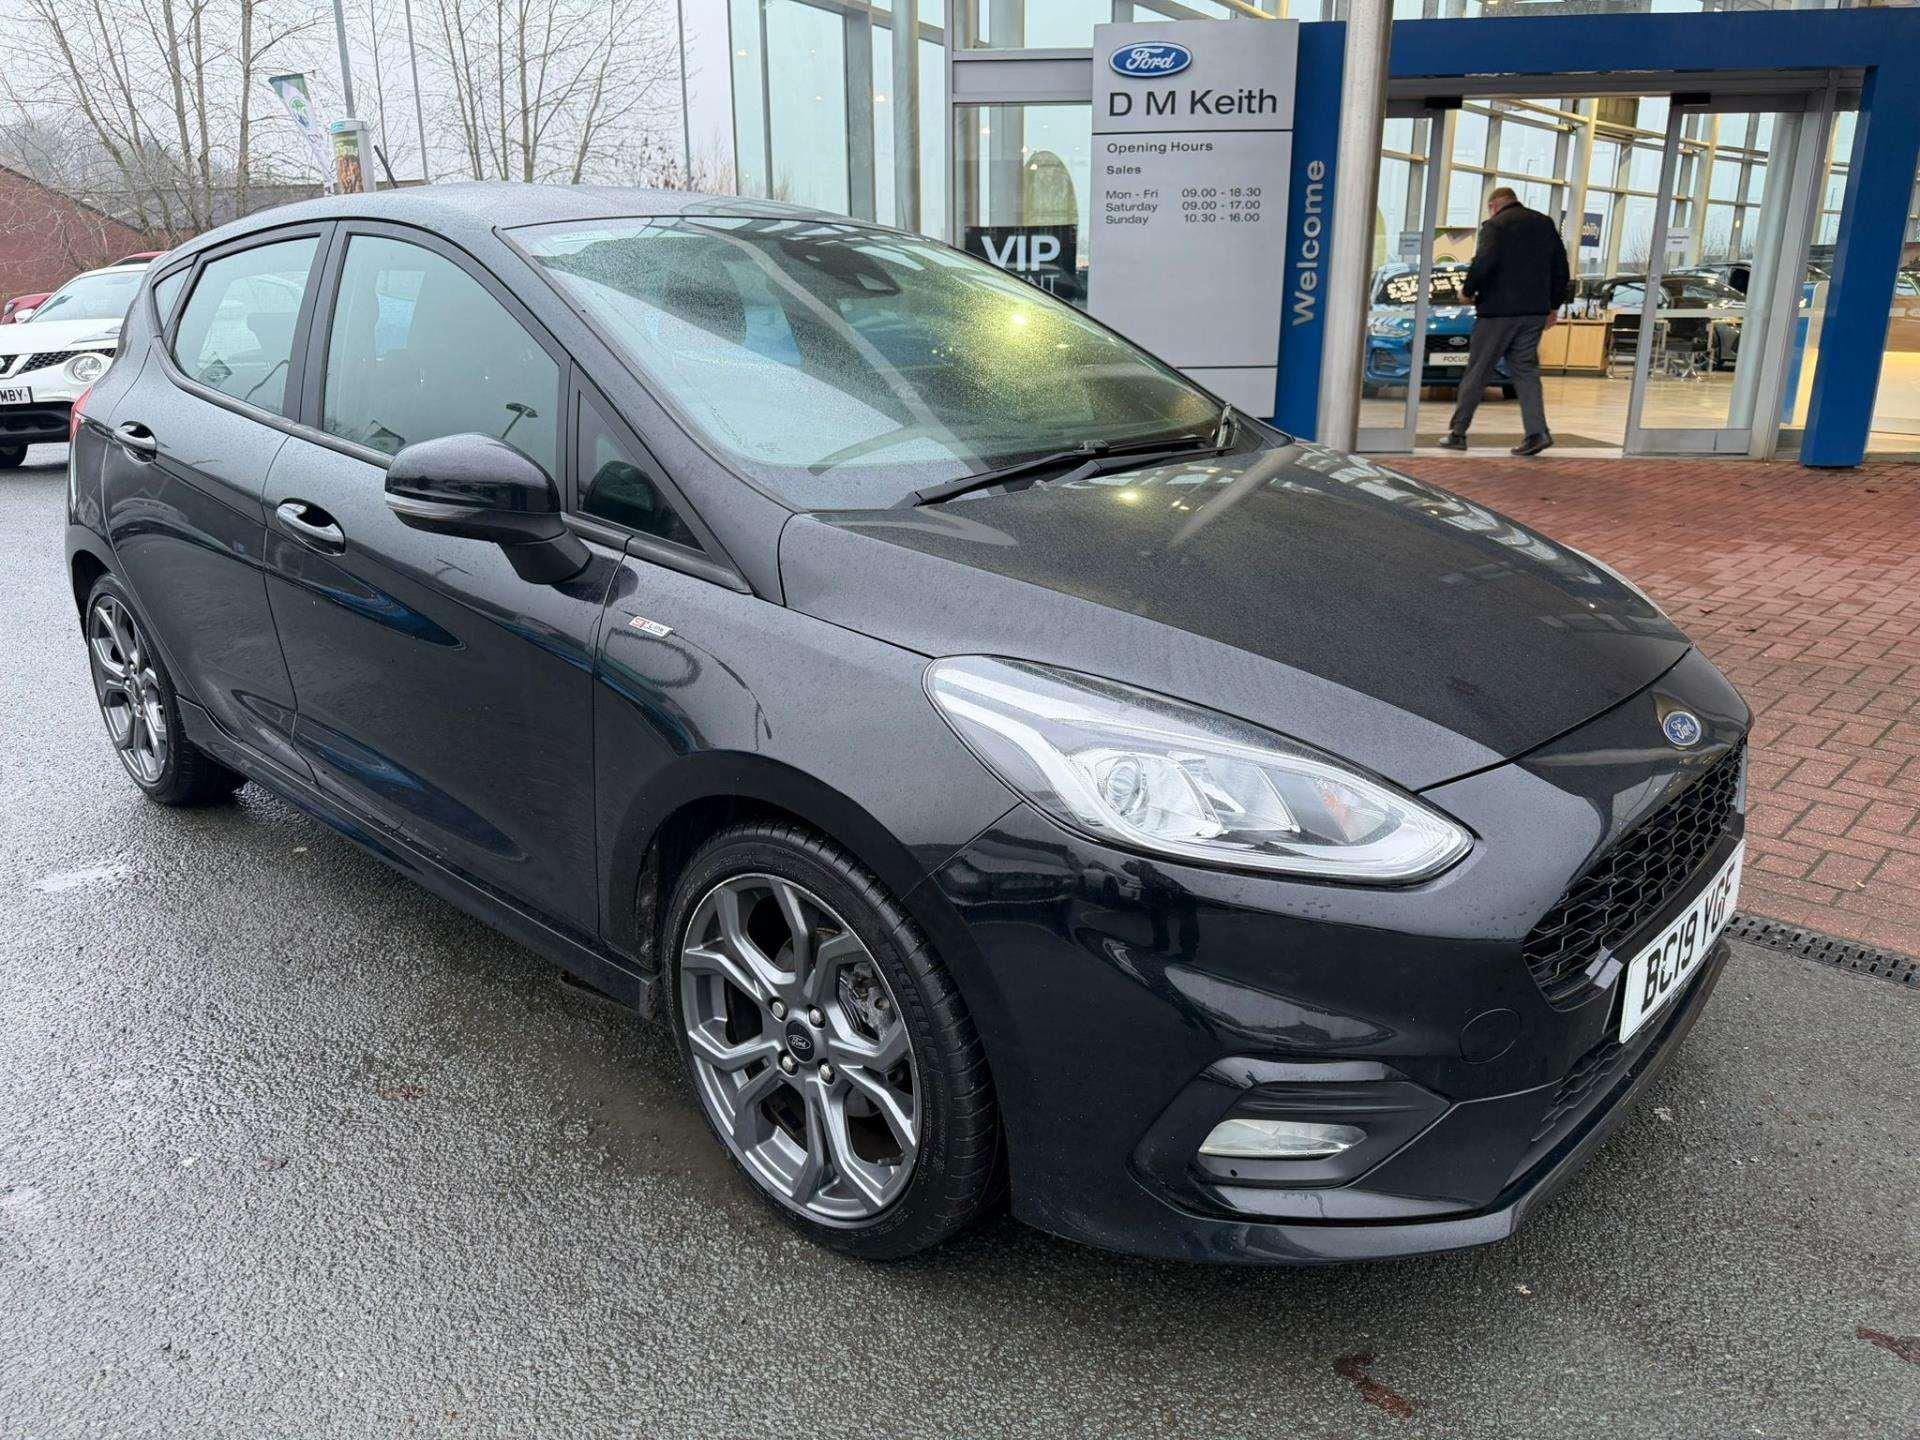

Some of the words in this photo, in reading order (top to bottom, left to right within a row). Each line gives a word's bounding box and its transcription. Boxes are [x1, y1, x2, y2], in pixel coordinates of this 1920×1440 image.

[1126, 47, 1176, 70] Ford
[1109, 92, 1133, 117] D
[1146, 90, 1176, 116] M
[1190, 88, 1277, 115] Keith
[1106, 142, 1167, 155] Opening
[1170, 141, 1213, 152] Hours
[1106, 165, 1142, 175] Sales
[1105, 189, 1132, 200] Mon
[1143, 189, 1158, 199] Fri
[1181, 188, 1217, 198] 09.00
[1229, 187, 1261, 198] 18.30
[1105, 202, 1158, 213] Saturday
[1181, 200, 1217, 211] 09.00
[1229, 200, 1261, 210] 17.00
[1105, 214, 1149, 226] Sunday
[1184, 213, 1216, 223] 10.30
[1229, 213, 1261, 223] 16.00
[1292, 160, 1325, 327] Welcome
[981, 235, 1060, 271] VIP
[0, 389, 23, 402] MBY
[1641, 909, 1699, 1014] BC19
